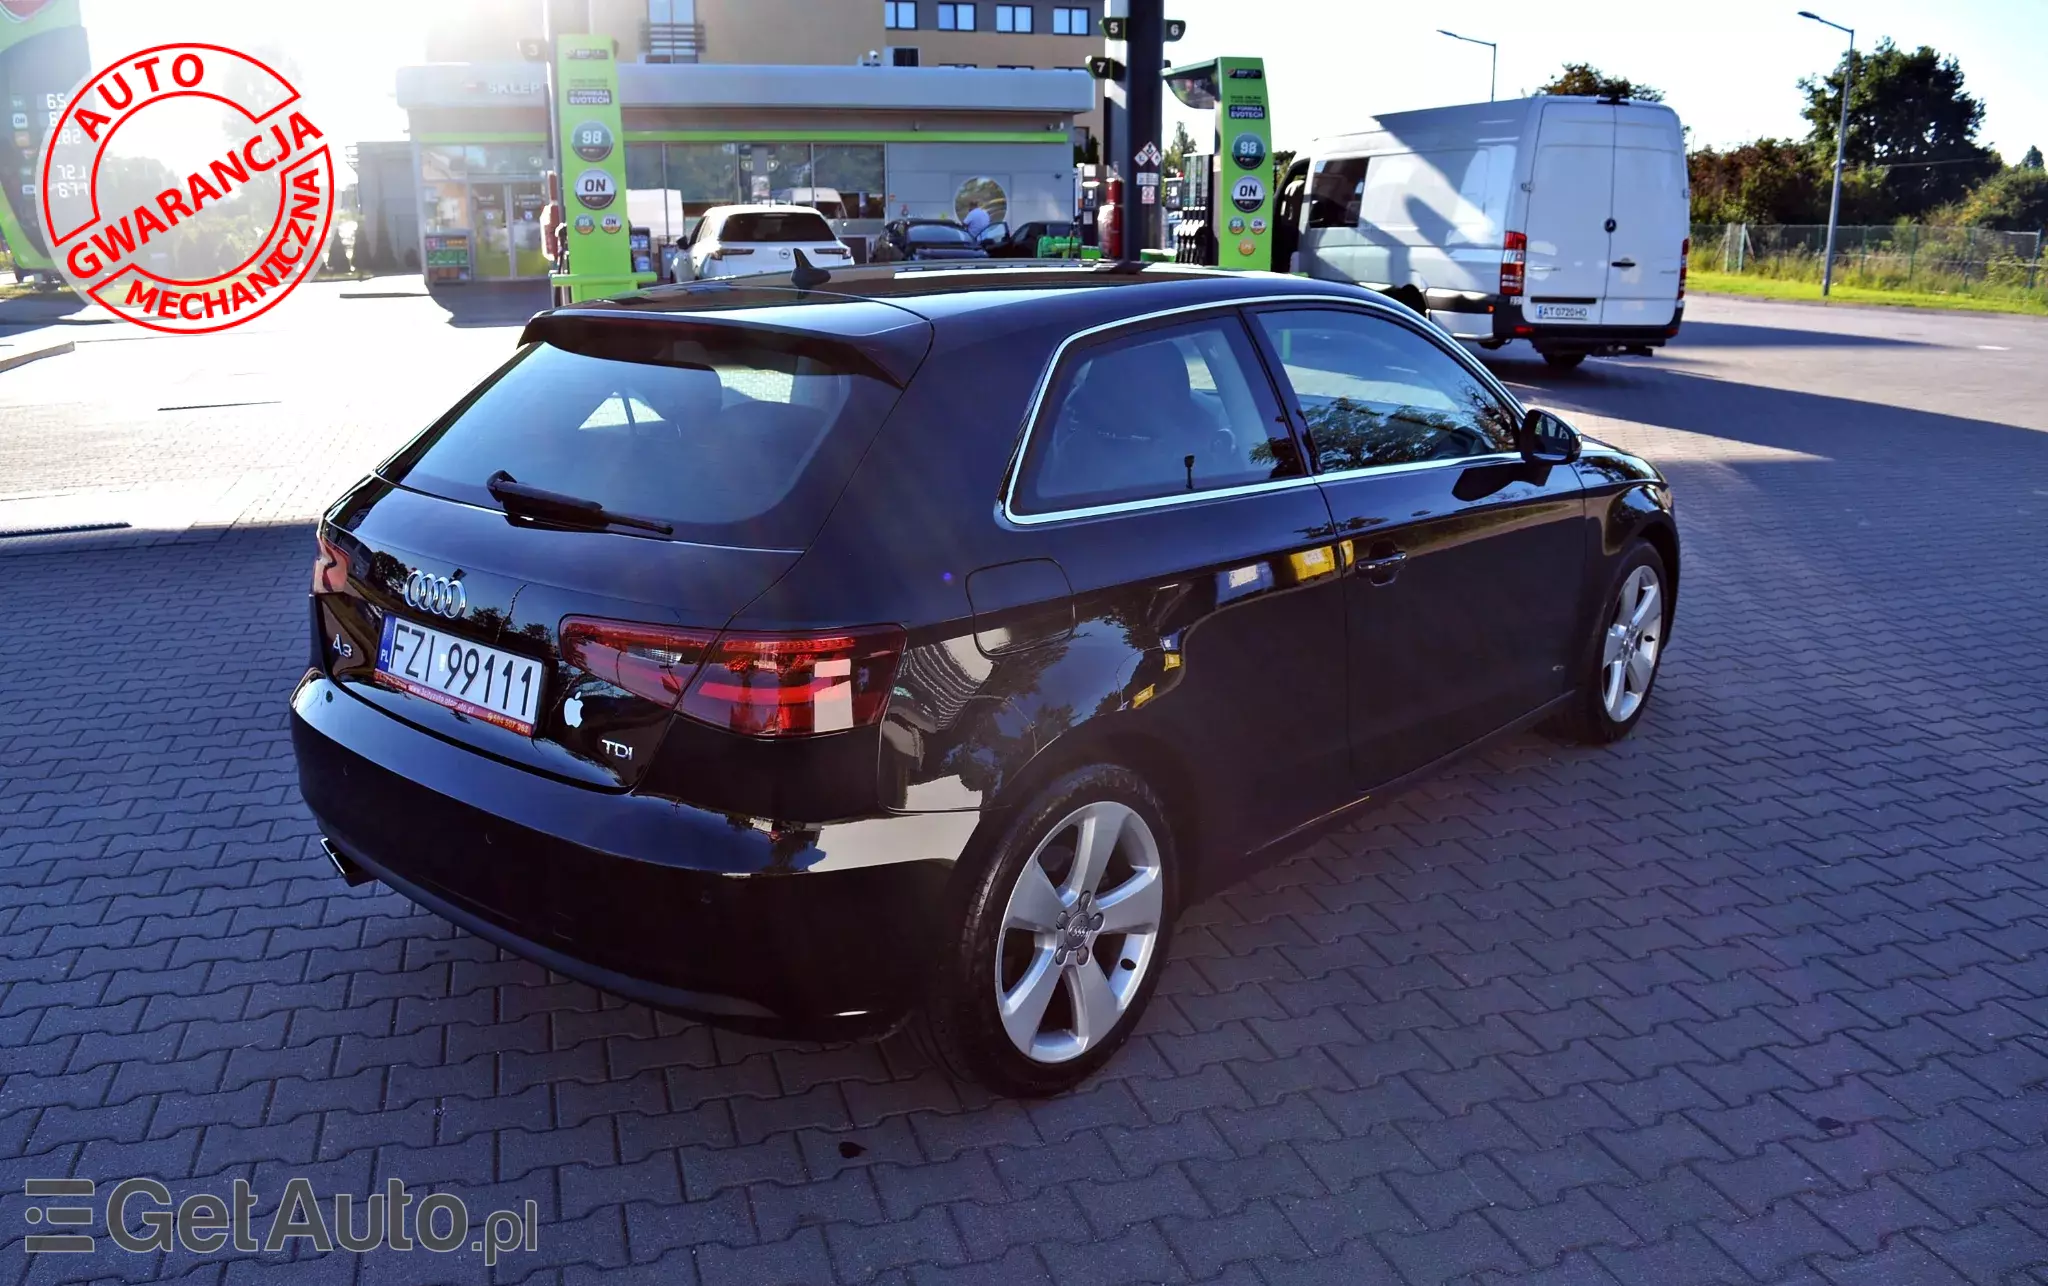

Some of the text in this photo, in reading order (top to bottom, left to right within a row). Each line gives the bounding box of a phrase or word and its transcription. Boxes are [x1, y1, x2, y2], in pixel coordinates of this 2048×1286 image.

[1109, 22, 1119, 34] 5
[1170, 24, 1180, 36] 6
[527, 43, 539, 56] 3
[1096, 61, 1106, 73] 7
[488, 82, 540, 95] SKLEP
[569, 96, 611, 104] EVOTECH
[582, 130, 602, 144] 98
[1240, 141, 1258, 154] 98
[585, 179, 606, 192] ON
[1239, 185, 1258, 197] ON
[605, 218, 617, 226] ON
[1253, 219, 1263, 227] ON
[1543, 307, 1554, 316] AT
[332, 633, 352, 658] A3
[380, 648, 389, 663] PL
[390, 624, 533, 716] FZI 99111
[601, 739, 633, 760] TDI
